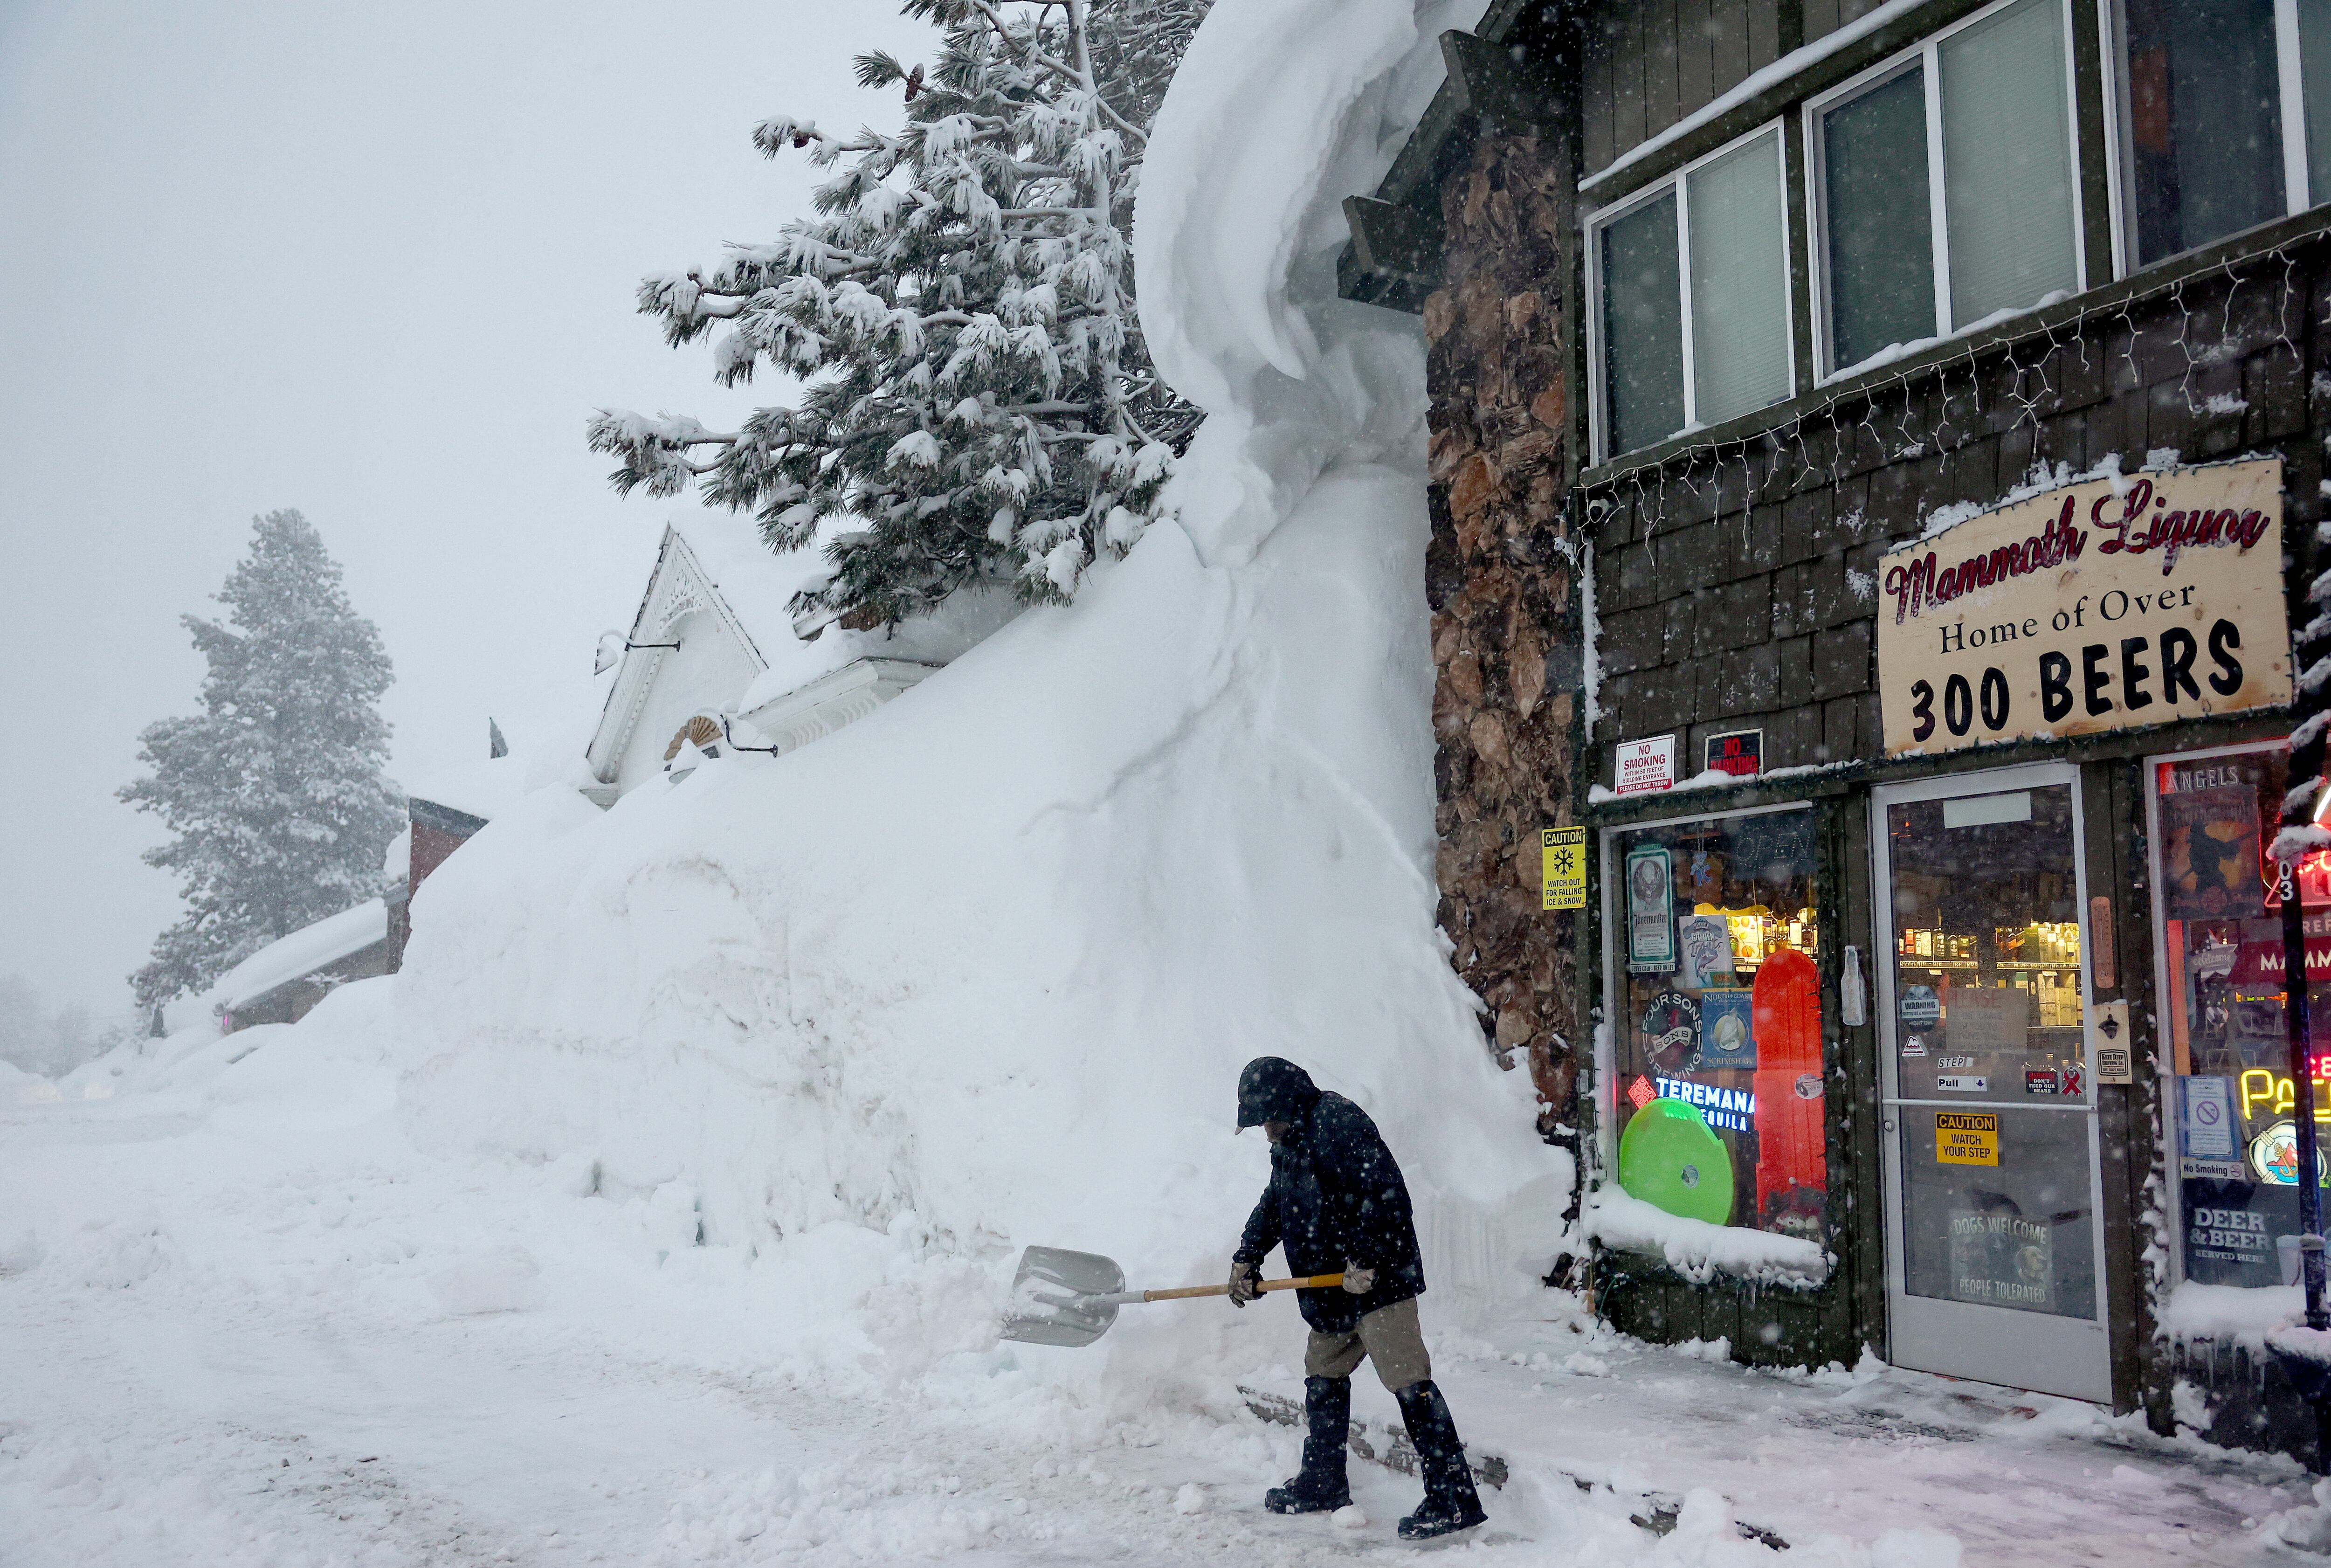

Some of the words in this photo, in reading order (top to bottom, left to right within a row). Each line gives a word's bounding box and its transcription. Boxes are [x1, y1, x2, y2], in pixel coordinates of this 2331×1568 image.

[1885, 495, 2088, 625] Mammoth
[2091, 479, 2271, 576] Liquor
[1938, 617, 2038, 655] Home
[2052, 595, 2089, 631] of
[2100, 585, 2196, 621] Over
[1911, 667, 2010, 742] 300
[2039, 618, 2243, 723] BEERS
[1638, 744, 1650, 756] NO
[1724, 737, 1741, 757] NO
[1624, 753, 1665, 770] SMOKING
[1710, 754, 1759, 776] PARKING
[1622, 775, 1641, 784] BUILDING
[2165, 765, 2238, 793] ANGELS
[1545, 831, 1582, 845] CAUTION
[1548, 879, 1567, 887] WATCH
[1691, 932, 1715, 942] GOLDEN
[1704, 994, 1730, 1003] NORTH
[1733, 993, 1752, 1002] COAST
[1904, 1001, 1936, 1010] WARNING
[1642, 994, 1669, 1032] FOUR
[1672, 993, 1703, 1033] SONS
[1655, 1030, 1689, 1049] SONS
[1648, 1051, 1701, 1080] BREWING
[1939, 1058, 1963, 1068] STEP
[1939, 1078, 1958, 1087] Pull
[1655, 1077, 1756, 1114] TEREMANA
[1939, 1115, 1993, 1130] CAUTION
[1951, 1133, 1981, 1145] WATCH
[1943, 1146, 1966, 1157] YOUR
[1968, 1147, 1991, 1158] STEP
[2184, 1163, 2193, 1173] No
[2196, 1164, 2228, 1177] Smoking
[2194, 1207, 2266, 1231] DEER
[1954, 1216, 1985, 1236] DOGS
[1987, 1216, 2047, 1245] WELCOME
[2208, 1229, 2272, 1251] BEER
[2196, 1250, 2235, 1260] SERVED
[1959, 1279, 1992, 1297] PEOPLE
[1995, 1281, 2046, 1303] TOLERATED
